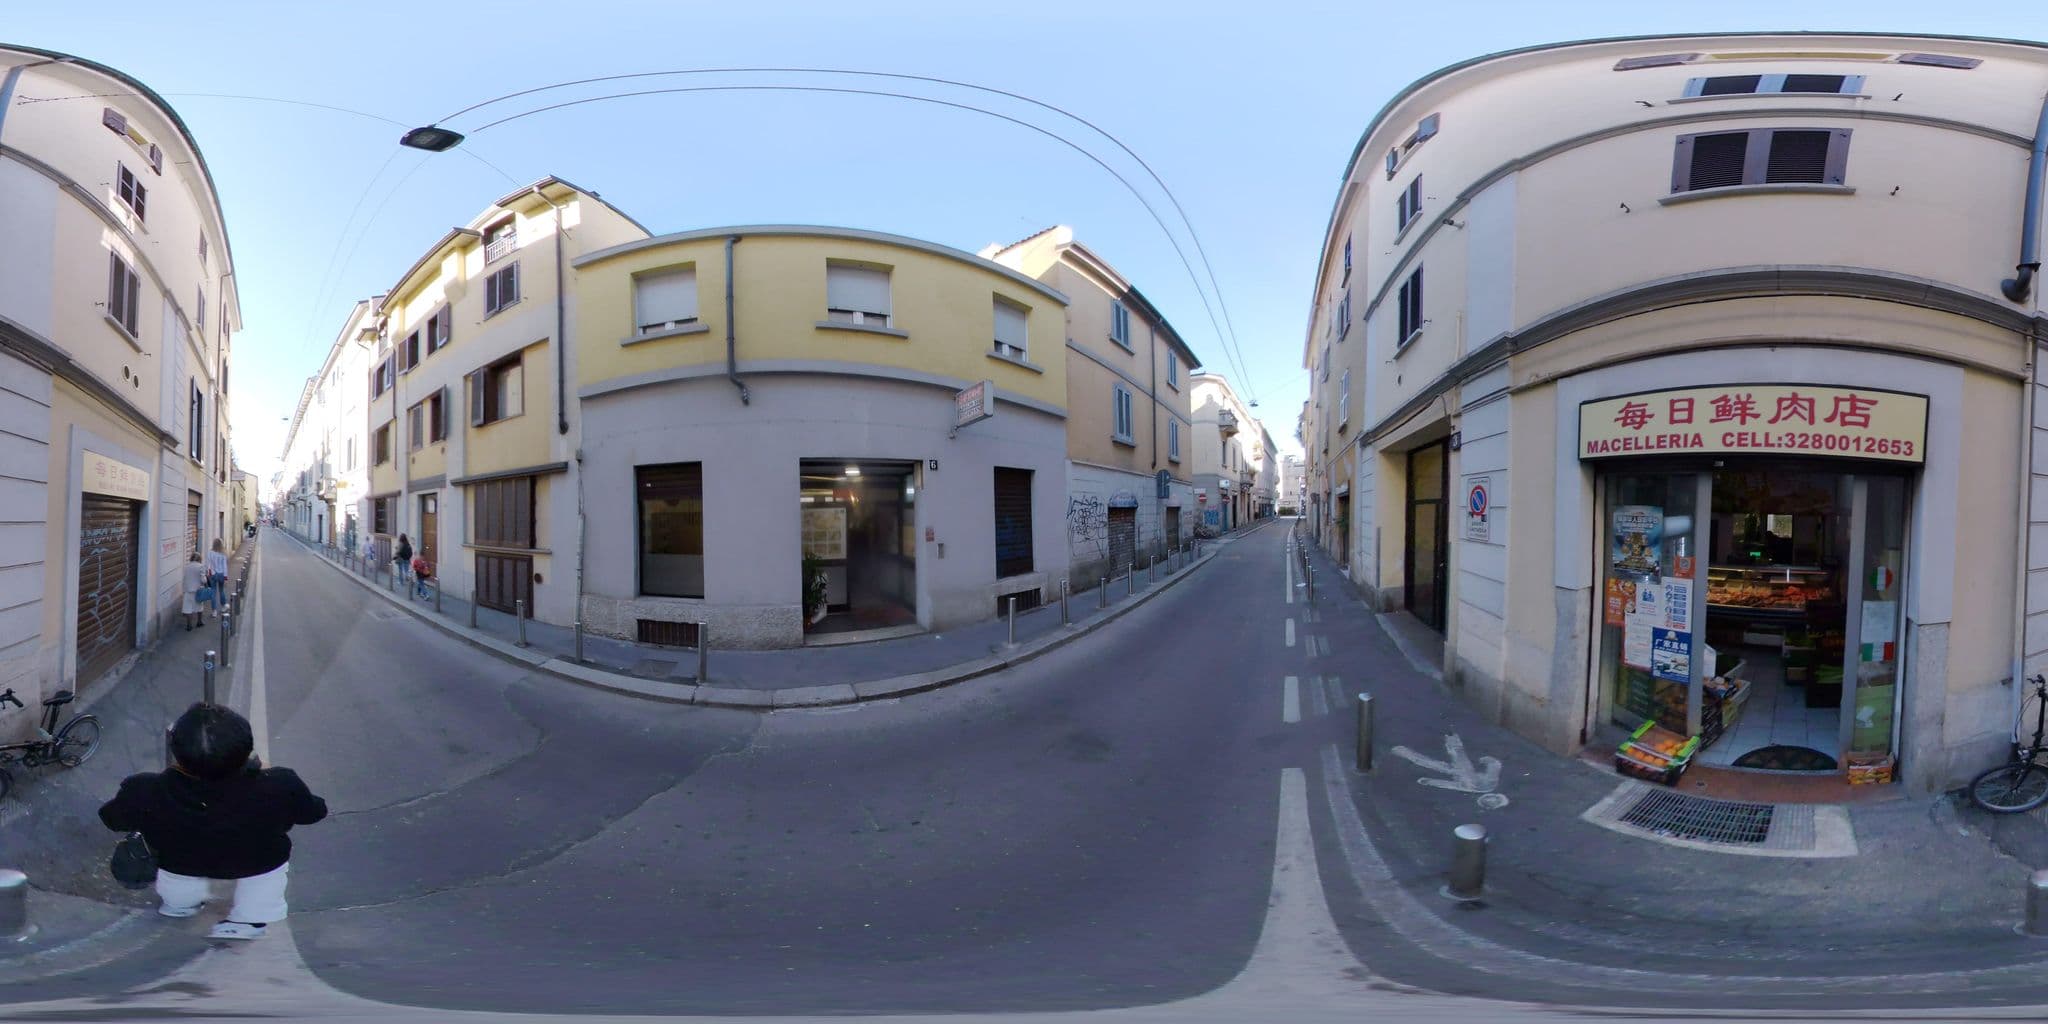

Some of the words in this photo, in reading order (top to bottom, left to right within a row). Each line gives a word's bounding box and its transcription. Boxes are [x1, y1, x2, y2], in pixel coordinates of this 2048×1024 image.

[1614, 391, 1879, 430] 每日鲜肉店
[1587, 432, 1704, 454] MACELLERIA
[1721, 431, 1914, 456] CELL:3280012653
